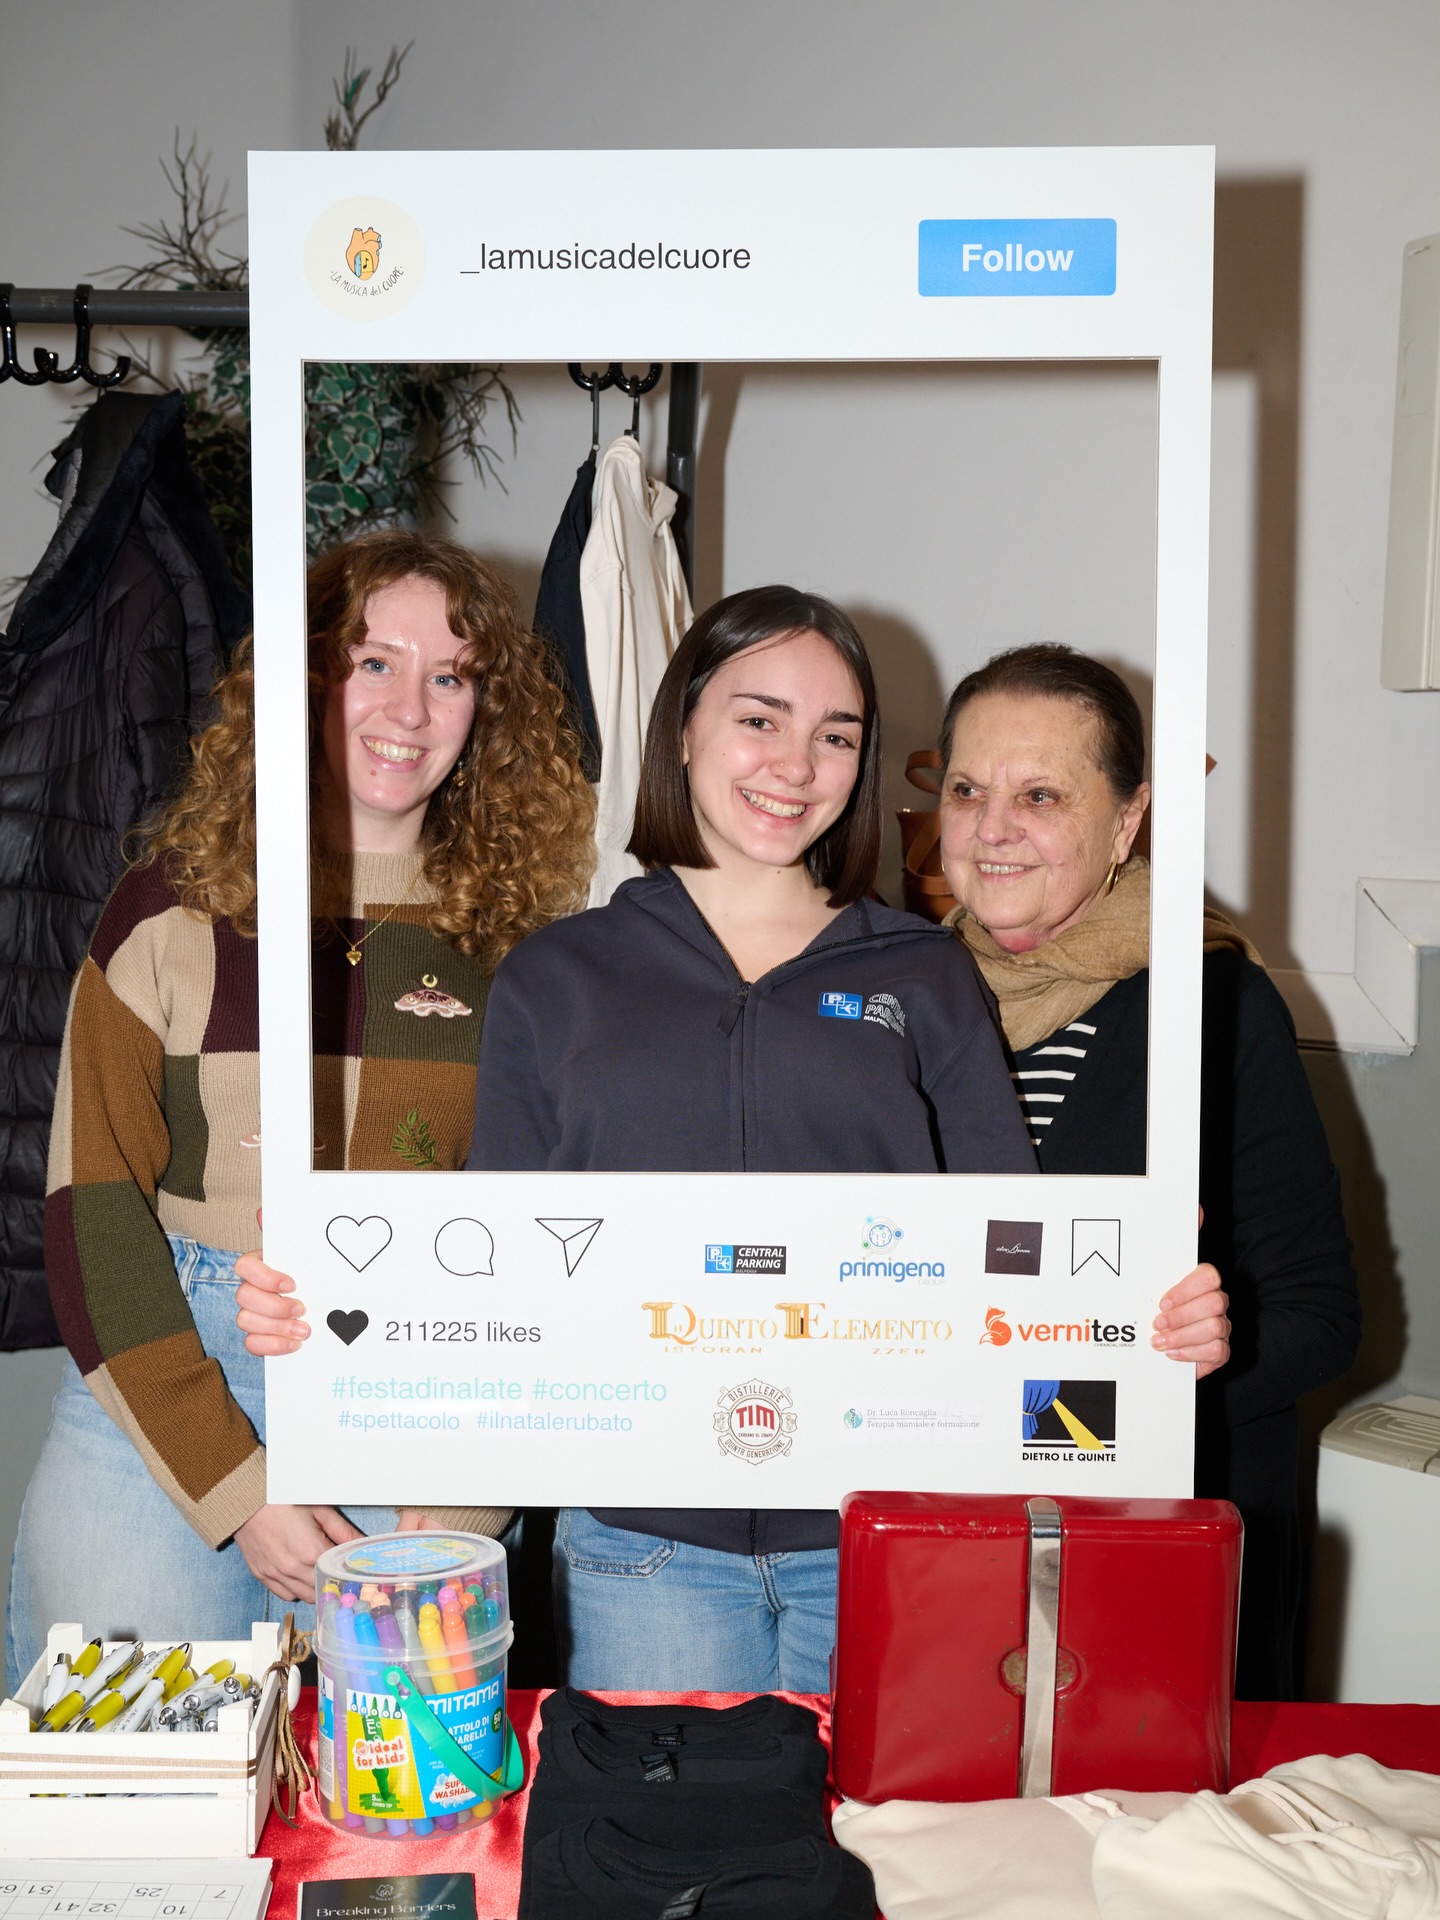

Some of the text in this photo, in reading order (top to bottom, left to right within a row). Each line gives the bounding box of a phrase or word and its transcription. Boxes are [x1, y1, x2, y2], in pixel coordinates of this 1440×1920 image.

[460, 242, 751, 274] _lamusicadelcuore
[962, 243, 1074, 273] Follow
[330, 270, 342, 285] LA
[382, 266, 404, 291] CUORE
[738, 1247, 784, 1257] CENTRAL
[736, 1259, 781, 1268] PARKING
[840, 1257, 945, 1283] primigena
[917, 1278, 945, 1286] GROUP
[385, 1320, 542, 1344] 211225 likes
[1018, 1318, 1136, 1343] vernites
[331, 1376, 668, 1402] #festadinalate #concerto
[728, 1384, 784, 1403] DISTILLERIE
[338, 1410, 633, 1433] #spettacolo #ilnatalerubato
[735, 1404, 775, 1431] TIM
[880, 1409, 898, 1417] Luca
[900, 1408, 937, 1418] Roncaglia
[867, 1420, 895, 1429] Terapia
[896, 1420, 930, 1428] manuale
[937, 1420, 980, 1428] formazione
[724, 1438, 785, 1458] QUINTA GENERAZIONE
[1022, 1452, 1116, 1462] DIETRO LE QUINTE
[426, 1680, 500, 1716] MITAMA
[448, 1715, 490, 1736] ATTOLO DI
[454, 1727, 487, 1744] ARELLI
[369, 1739, 403, 1754] ideal
[357, 1752, 406, 1768] for kids
[435, 1787, 470, 1799] WASHAB
[444, 1779, 464, 1790] SUP
[27, 1884, 54, 1895] 51
[135, 1887, 164, 1898] 25
[213, 1888, 227, 1899] 7
[54, 1901, 187, 1915] 10 32 41
[316, 1905, 387, 1919] Breaking
[391, 1902, 457, 1914] Barriers
